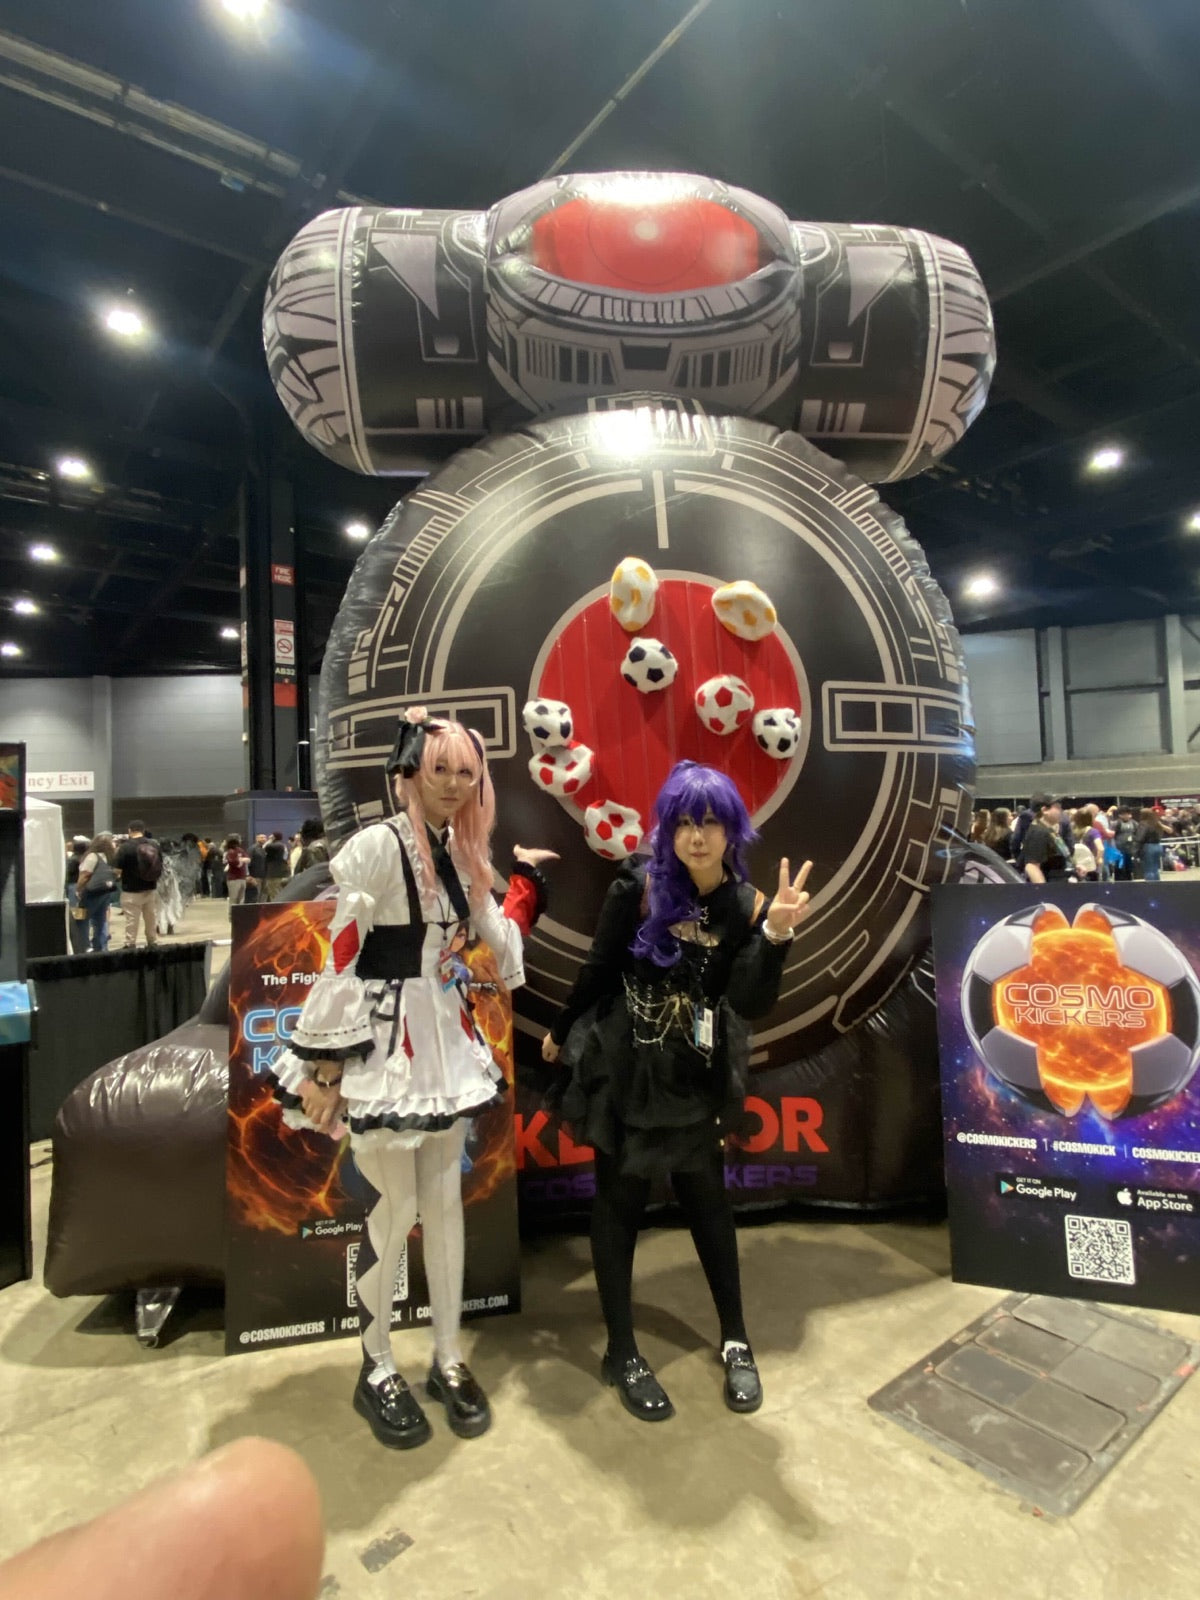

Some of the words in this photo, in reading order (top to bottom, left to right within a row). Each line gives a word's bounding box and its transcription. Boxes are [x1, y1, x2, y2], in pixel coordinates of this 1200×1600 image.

[58, 774, 88, 786] Exit
[261, 974, 288, 986] The
[291, 972, 321, 985] Figh
[1004, 983, 1155, 1010] COSMO
[1015, 1006, 1147, 1028] KICKERS
[957, 1131, 1037, 1150] @COSMOKICKERS
[1052, 1140, 1117, 1156] #COSMOKICK
[1132, 1147, 1200, 1164] COSMOKICKE
[724, 1164, 818, 1190] KERS
[1016, 1184, 1053, 1198] Google
[1054, 1187, 1077, 1201] Play
[1137, 1197, 1161, 1211] App
[1162, 1198, 1194, 1212] Store
[315, 1224, 345, 1236] Google
[345, 1222, 363, 1232] Play
[239, 1320, 325, 1344] @COSMOKICKERS
